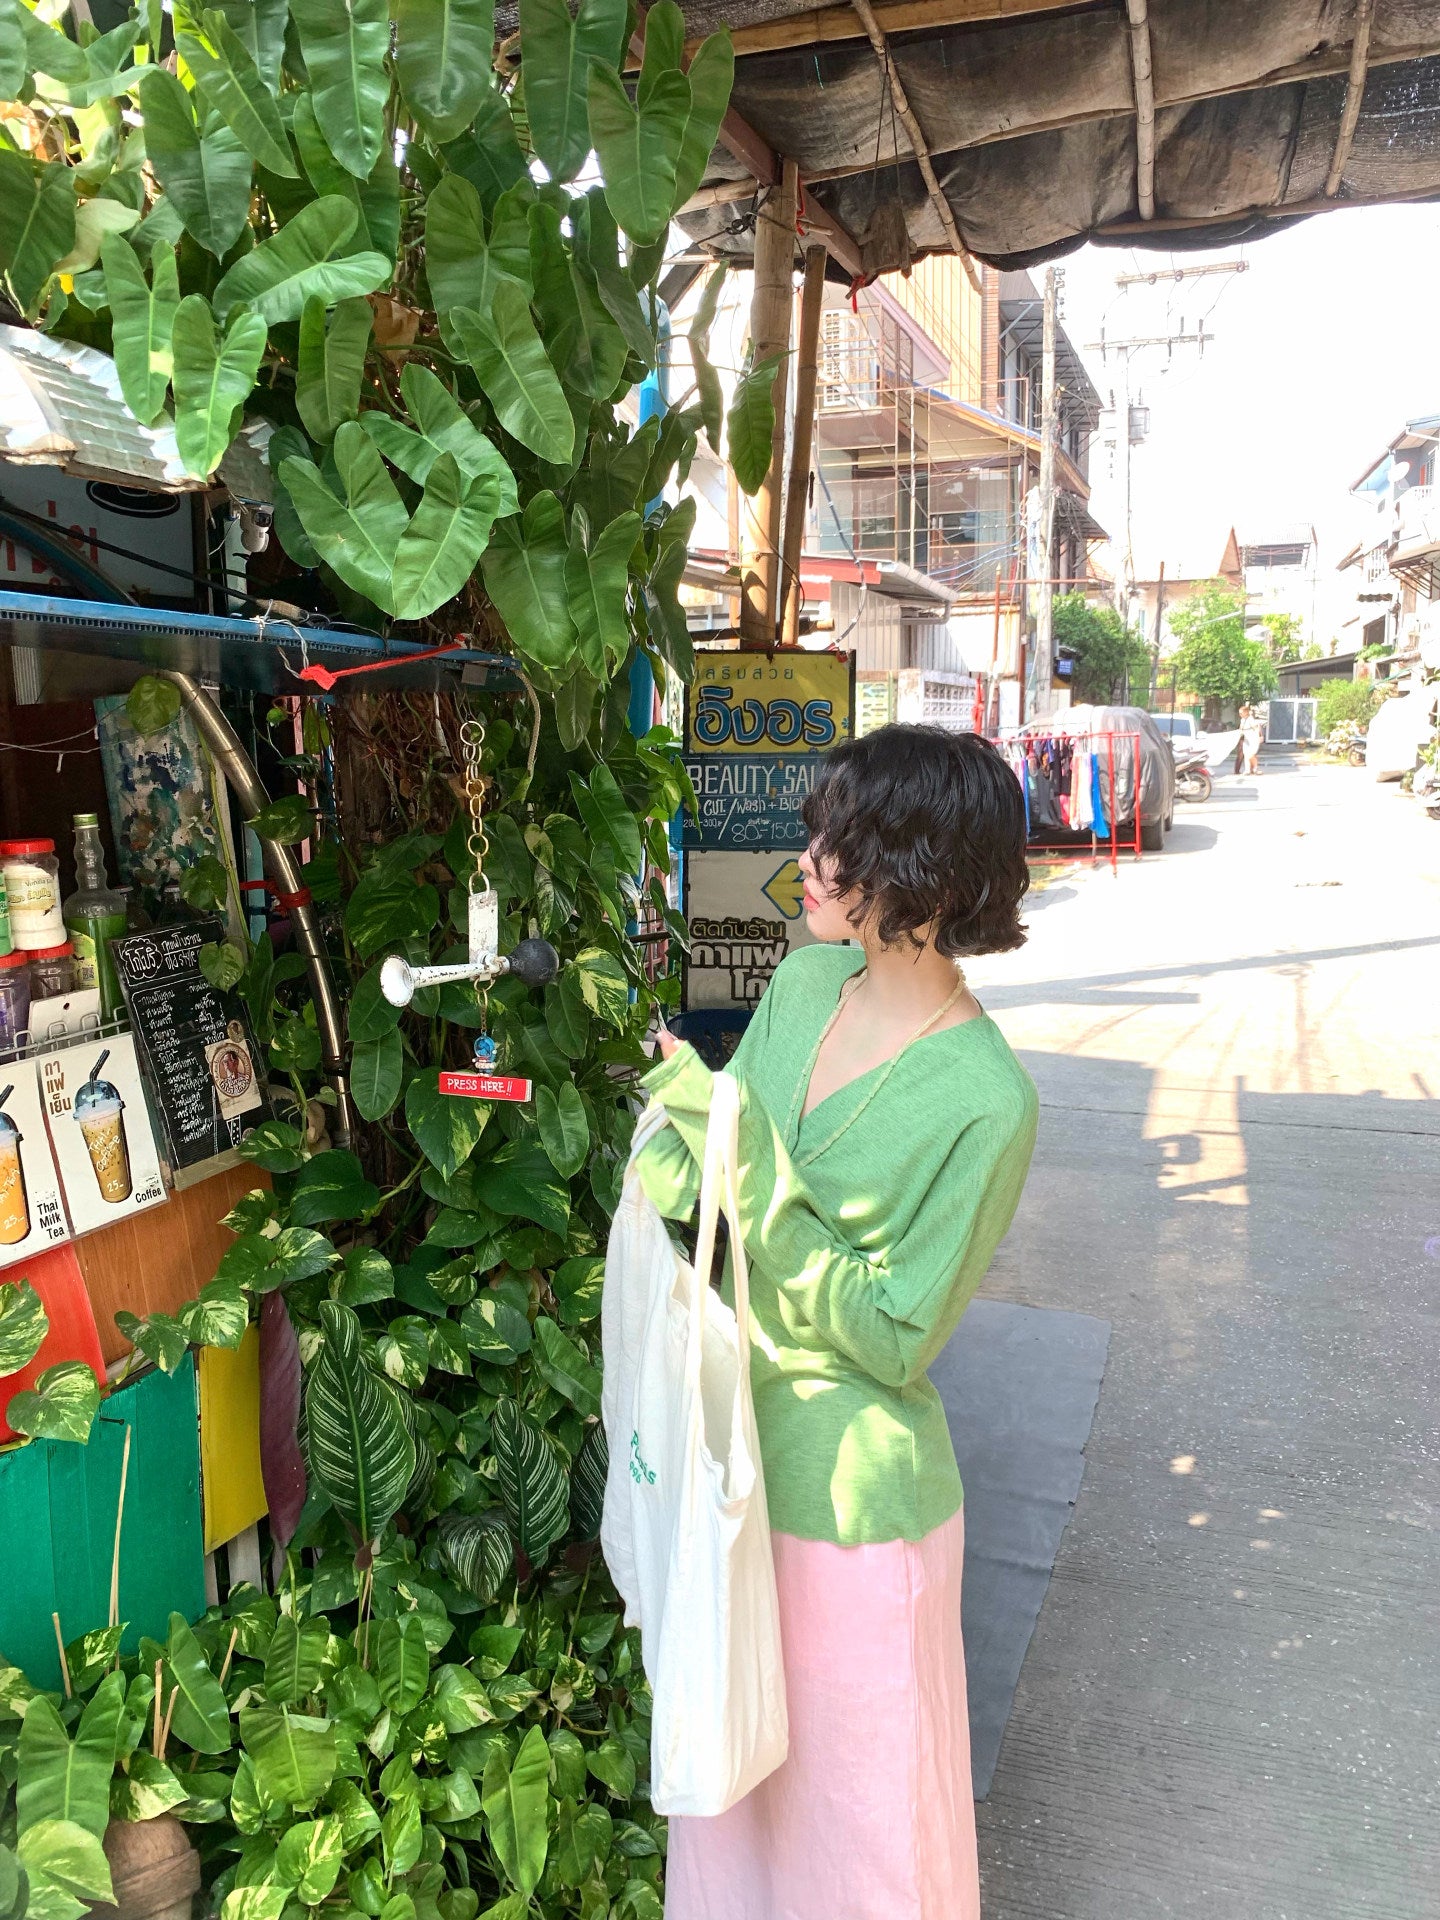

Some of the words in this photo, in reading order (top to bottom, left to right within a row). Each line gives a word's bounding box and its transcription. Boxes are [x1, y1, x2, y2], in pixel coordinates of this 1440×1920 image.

[695, 686, 836, 745] อิงอร
[686, 765, 776, 794] BEAUTY
[692, 919, 784, 938] ติดกับร้าน
[690, 941, 786, 967] กาแฟ
[447, 1078, 478, 1091] PRESS
[50, 1093, 72, 1115] เย็น
[135, 1187, 162, 1203] Coffee
[37, 1199, 59, 1215] Thai
[40, 1212, 62, 1229] Milk
[46, 1226, 65, 1240] Tea
